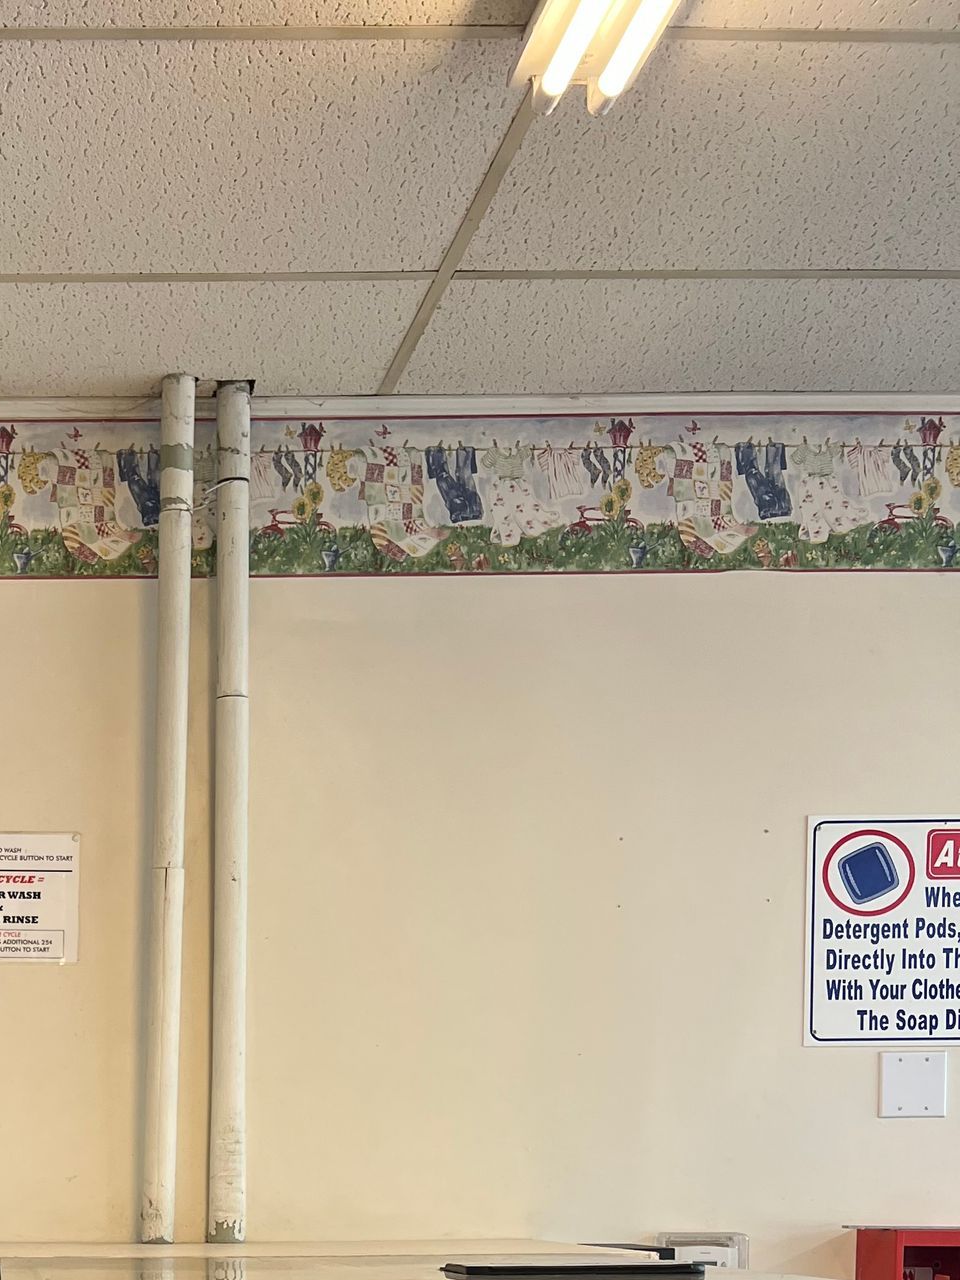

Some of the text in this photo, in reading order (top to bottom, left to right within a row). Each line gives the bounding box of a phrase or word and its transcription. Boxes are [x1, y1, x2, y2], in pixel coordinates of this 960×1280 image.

[925, 886, 960, 908] Whe
[822, 918, 909, 944] Detergent
[826, 948, 895, 975] Directly
[902, 948, 936, 969] Into
[826, 979, 863, 1000] With
[869, 979, 907, 1000] Your
[857, 1010, 889, 1030] The
[896, 1009, 938, 1035] Soap
